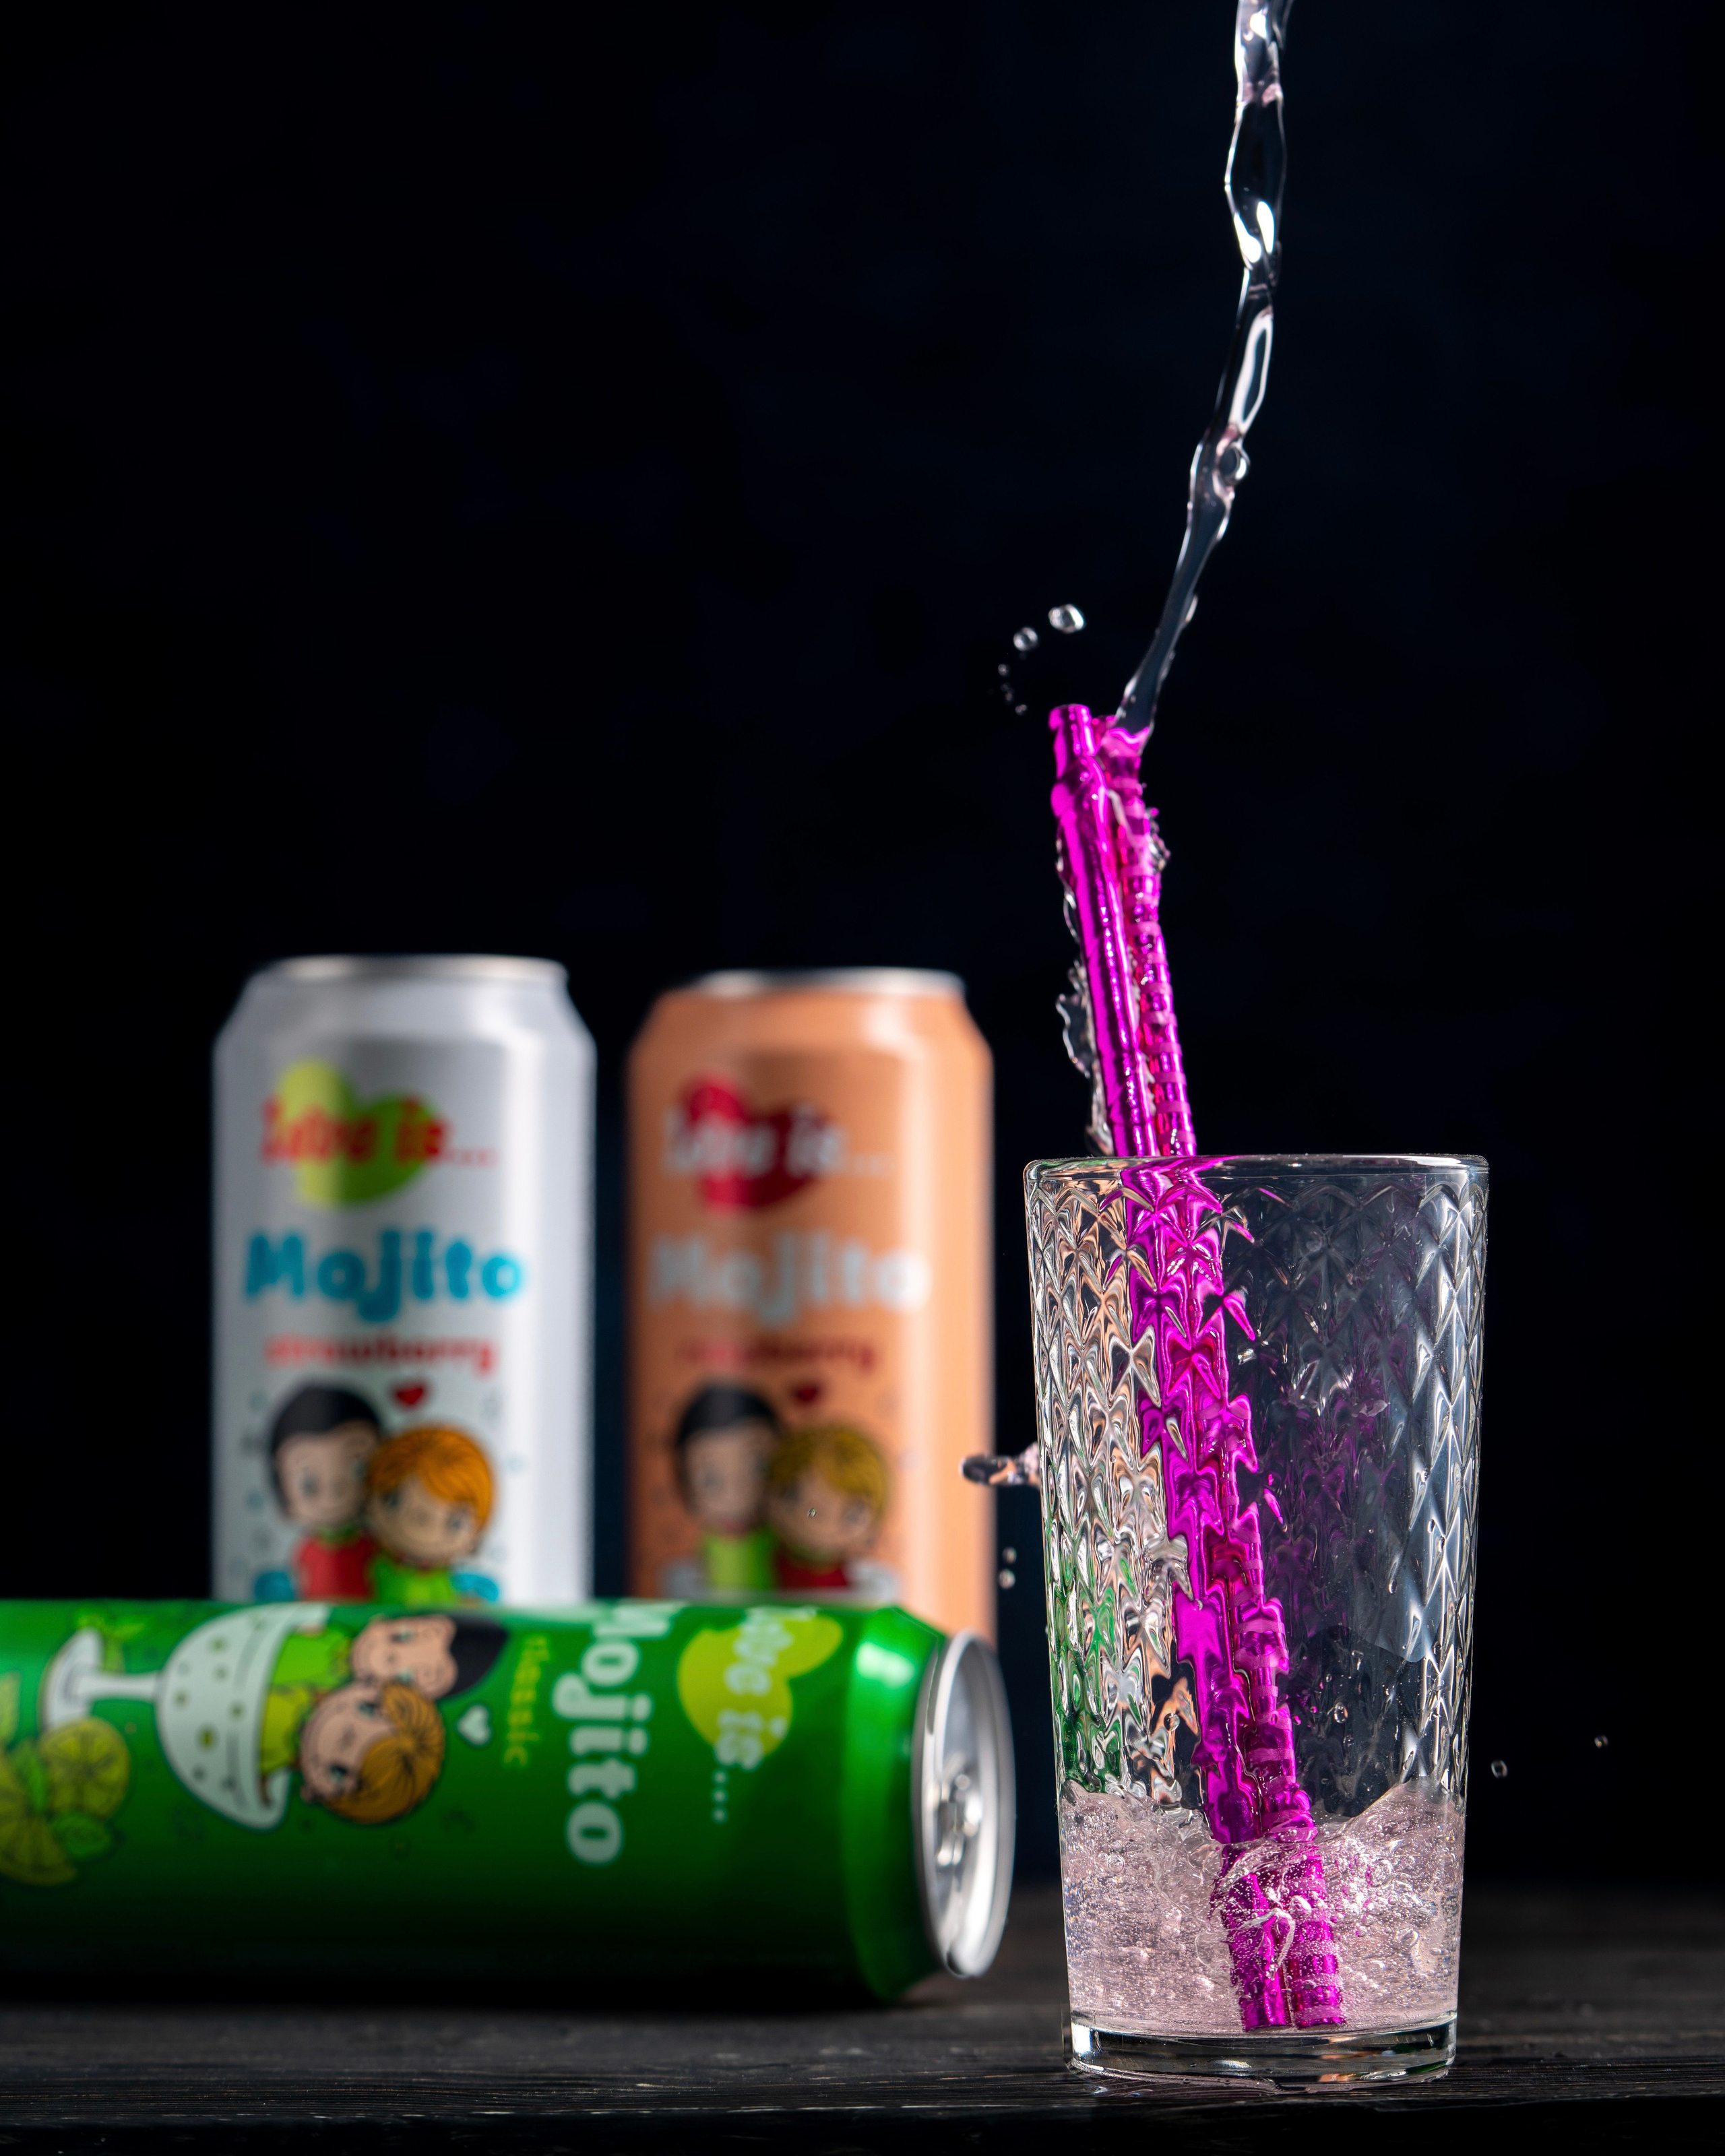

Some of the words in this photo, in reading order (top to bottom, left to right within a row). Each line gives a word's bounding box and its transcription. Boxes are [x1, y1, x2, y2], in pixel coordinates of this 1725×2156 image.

[245, 1229, 527, 1325] Mojito
[647, 1229, 935, 1330] Mojito
[551, 1598, 686, 1866] Mojito
